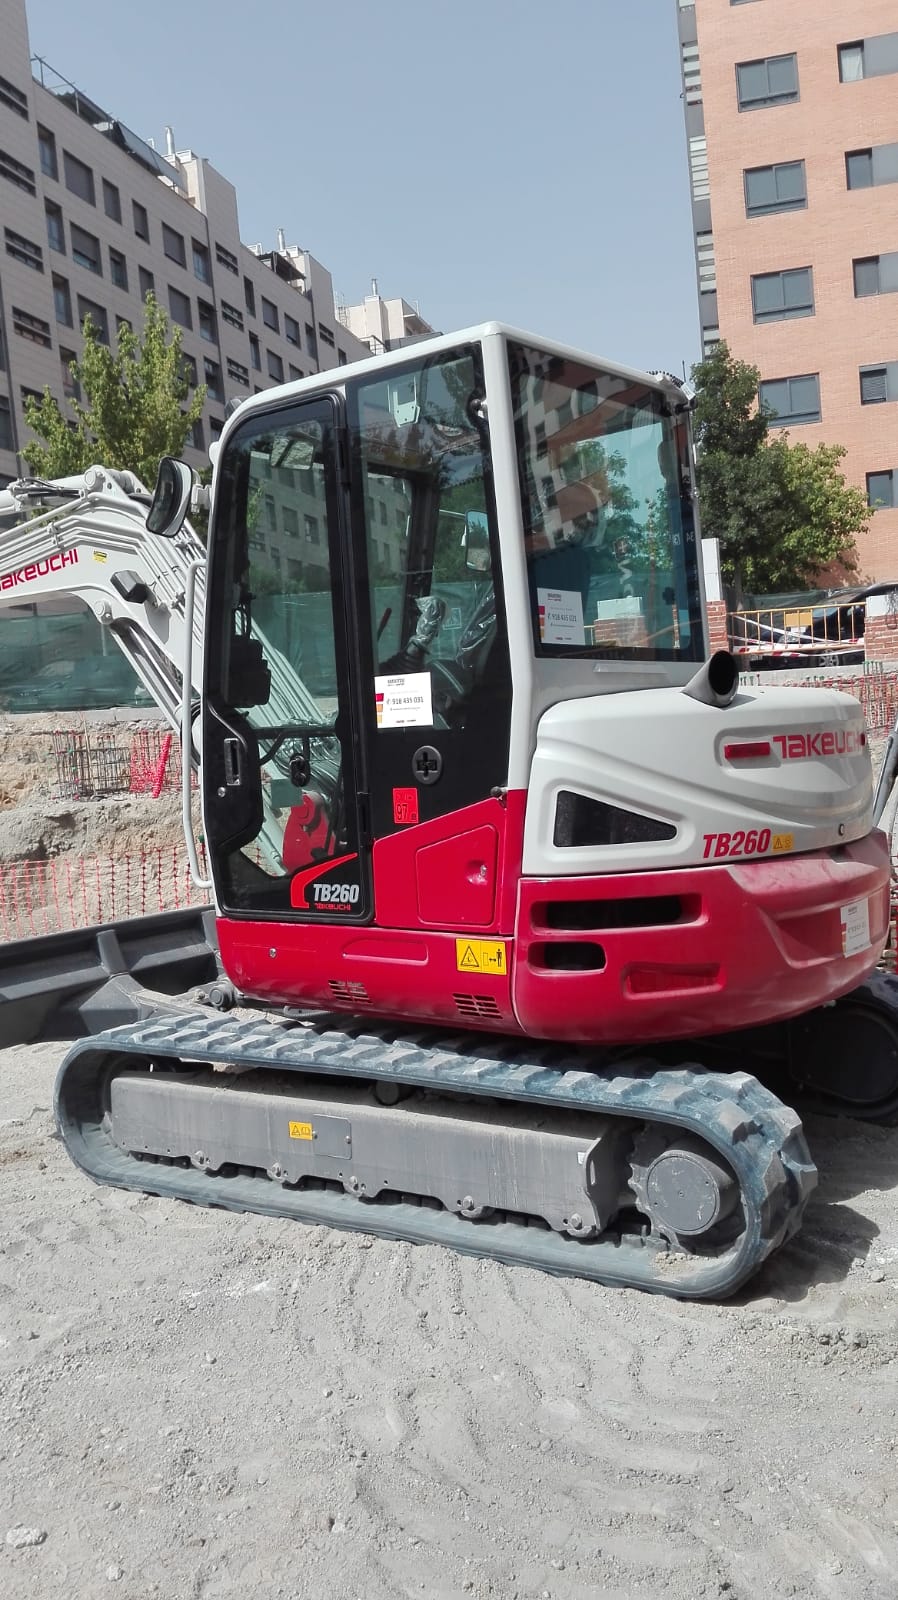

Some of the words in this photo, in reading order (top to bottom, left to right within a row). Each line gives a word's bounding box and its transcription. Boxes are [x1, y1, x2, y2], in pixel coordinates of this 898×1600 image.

[0, 548, 78, 591] AKEUCHI
[772, 731, 863, 759] TAKEUCH
[397, 803, 408, 820] 97
[703, 828, 771, 858] TB260
[313, 884, 360, 903] TB260
